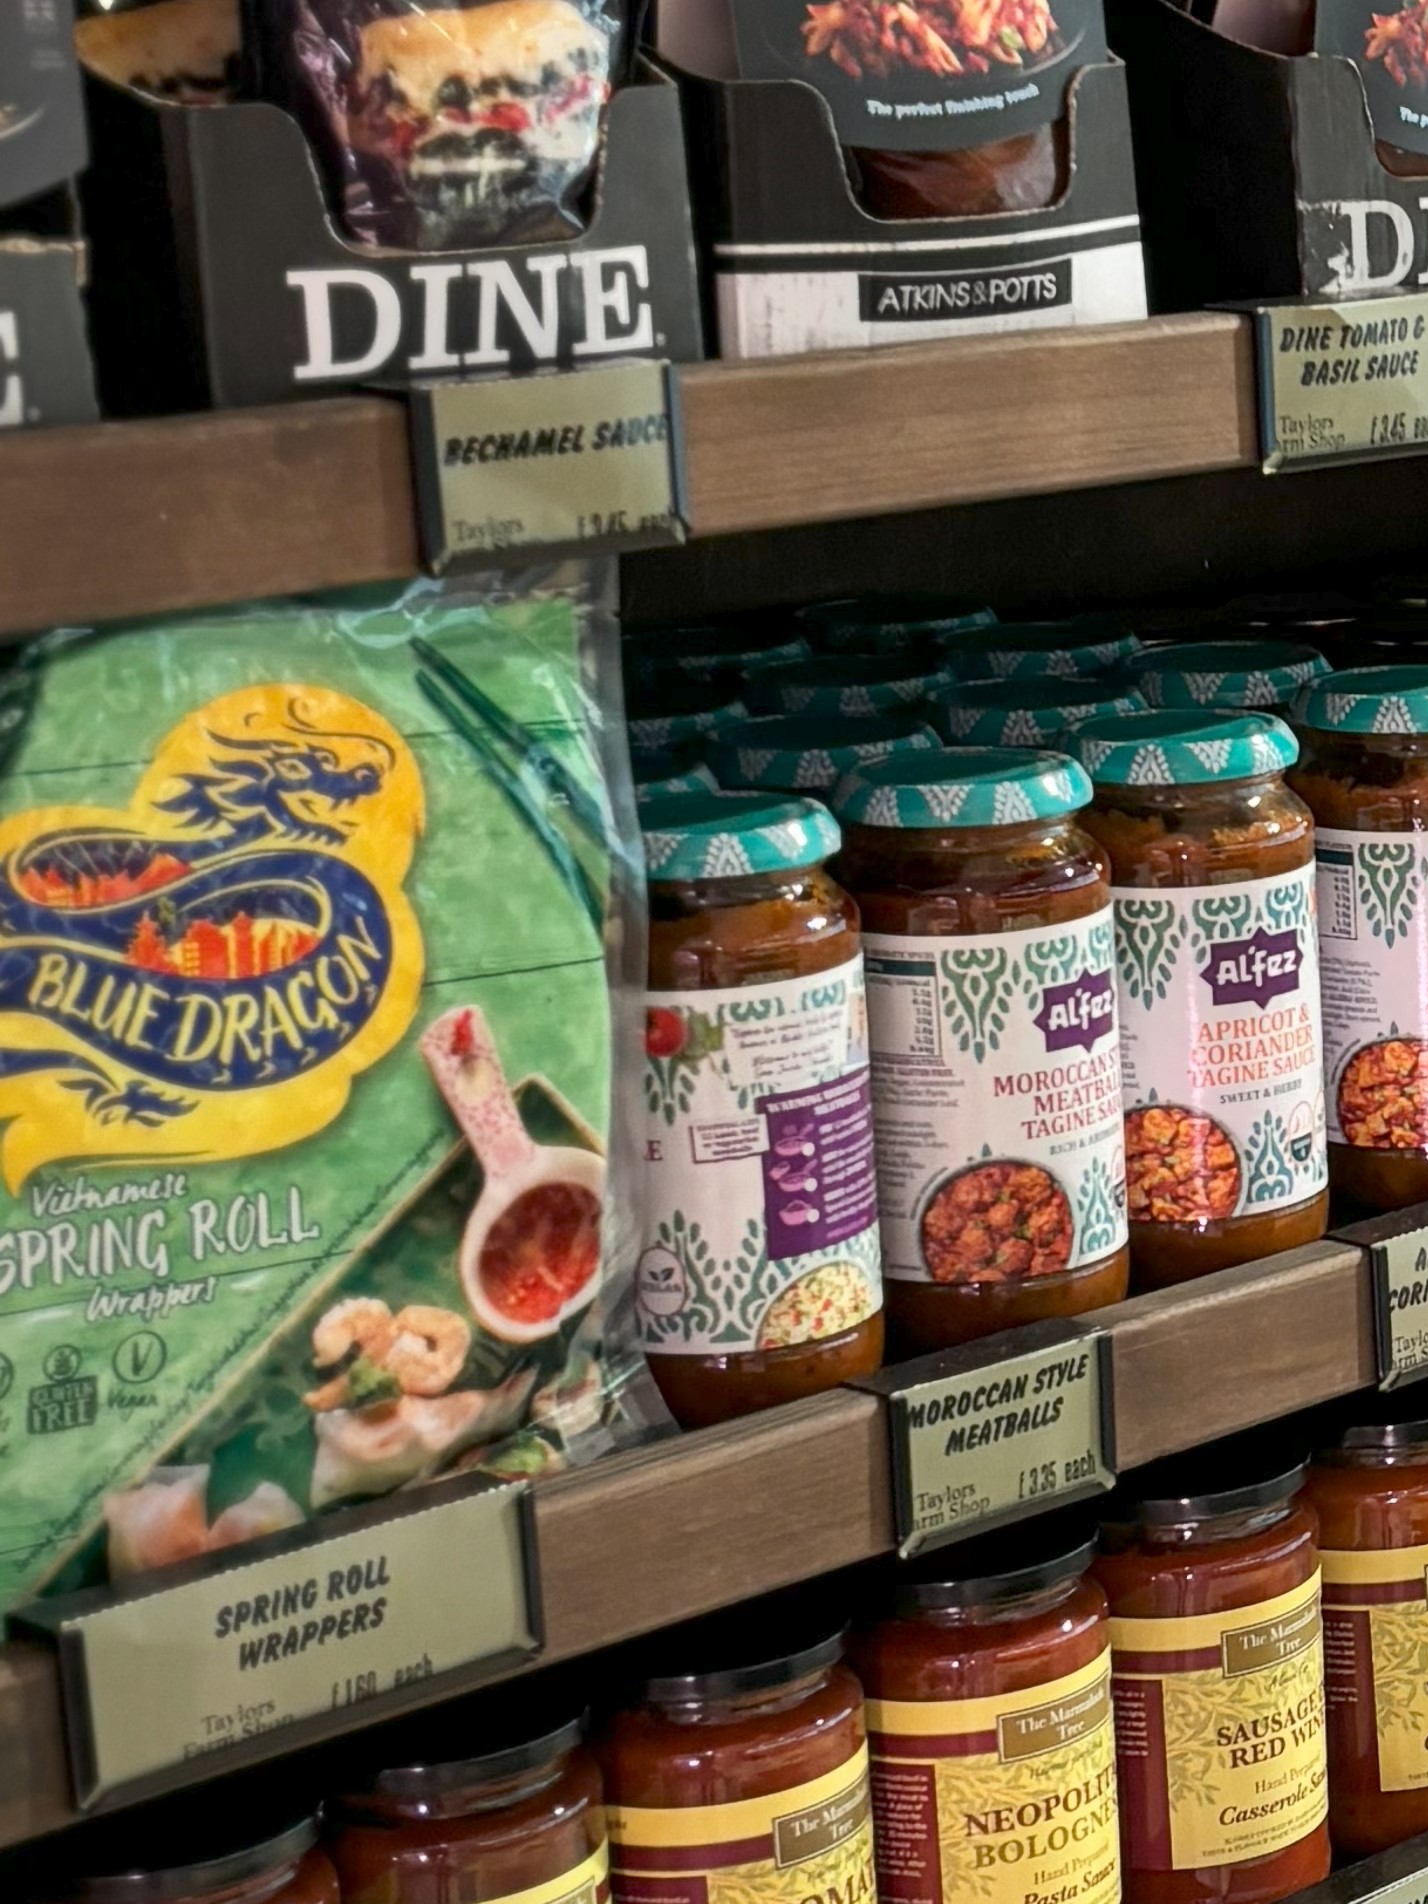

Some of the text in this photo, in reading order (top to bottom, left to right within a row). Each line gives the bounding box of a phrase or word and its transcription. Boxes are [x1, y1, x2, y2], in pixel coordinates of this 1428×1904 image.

[287, 246, 654, 380] DINE
[1279, 326, 1334, 354] DINE
[1340, 321, 1408, 350] TOMATO
[1300, 348, 1420, 387] BASIL SAUCE
[443, 414, 668, 466] BECHAMEL SAUCE
[28, 914, 386, 1062] BLUE DRAGON
[1198, 1011, 1295, 1044] APRICOT
[1186, 1058, 1264, 1090] TAGINE
[30, 1174, 189, 1218] Vietnamese
[191, 1188, 319, 1257] ROLL
[908, 1355, 1088, 1429] MOROCCAN STYLE
[945, 1397, 1061, 1455] MEATBALLS
[325, 1557, 390, 1610] ROLL
[238, 1598, 387, 1671] WRAPPERS
[1229, 1738, 1285, 1771] RED
[1218, 1781, 1304, 1826] Casserole
